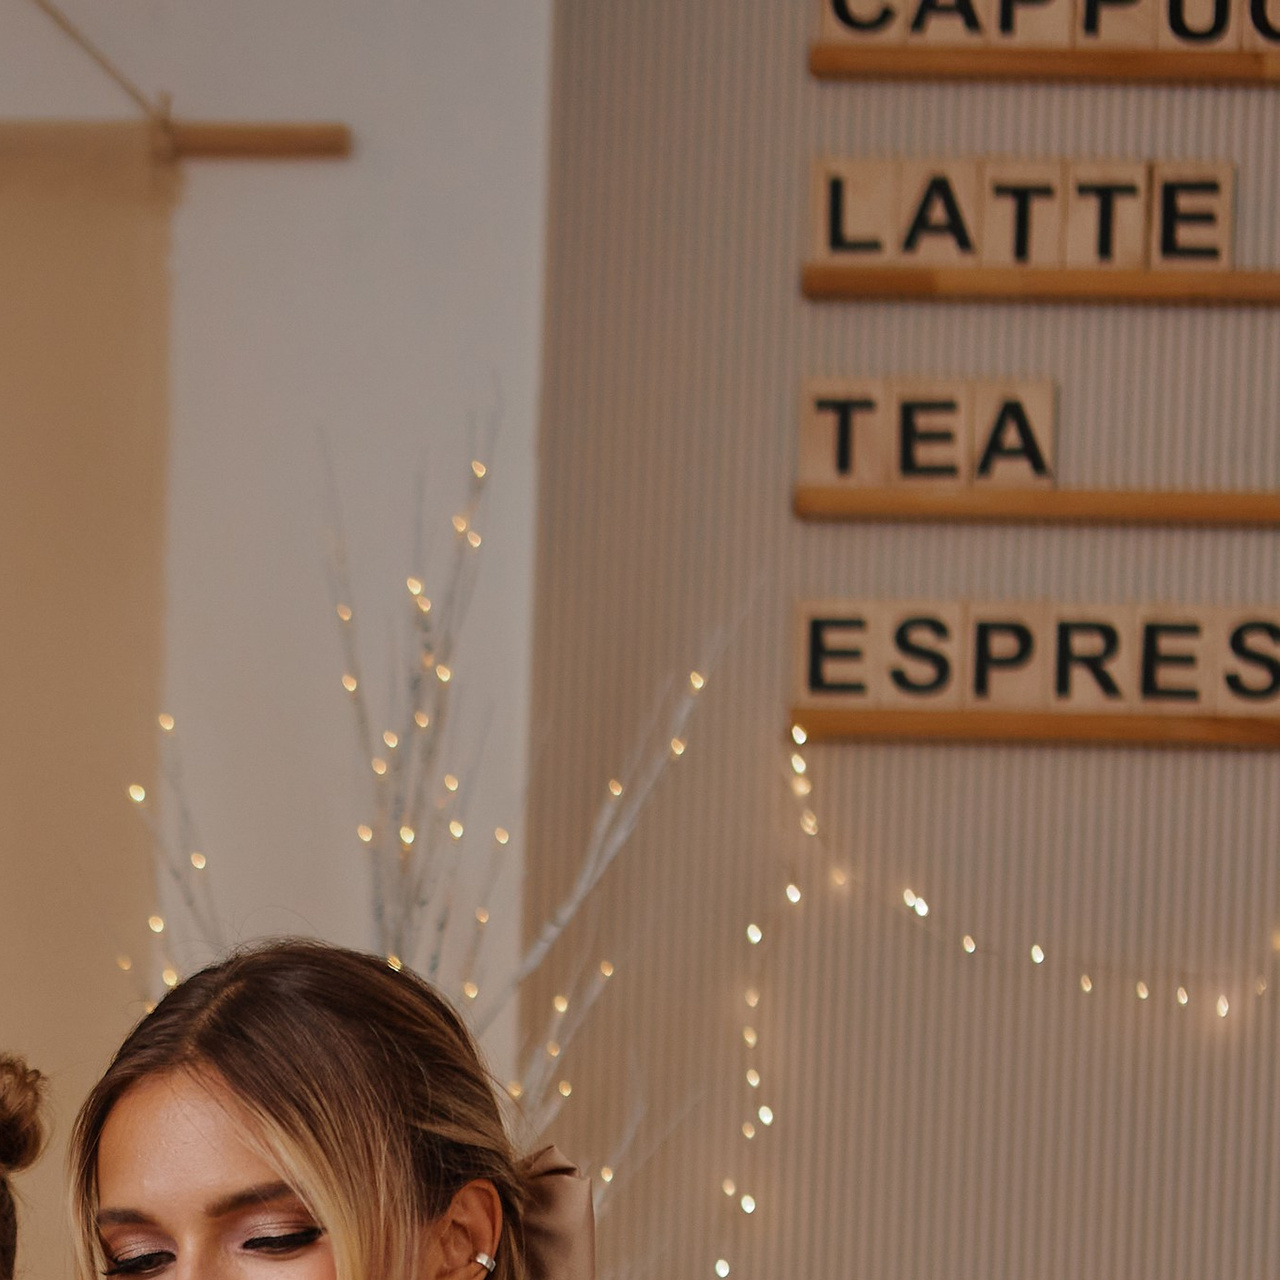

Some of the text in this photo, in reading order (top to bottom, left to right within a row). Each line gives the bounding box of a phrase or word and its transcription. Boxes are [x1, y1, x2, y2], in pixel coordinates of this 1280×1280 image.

[827, 176, 1221, 261] LATTE
[815, 398, 1049, 478] TEA
[807, 617, 1280, 701] ESPRES
